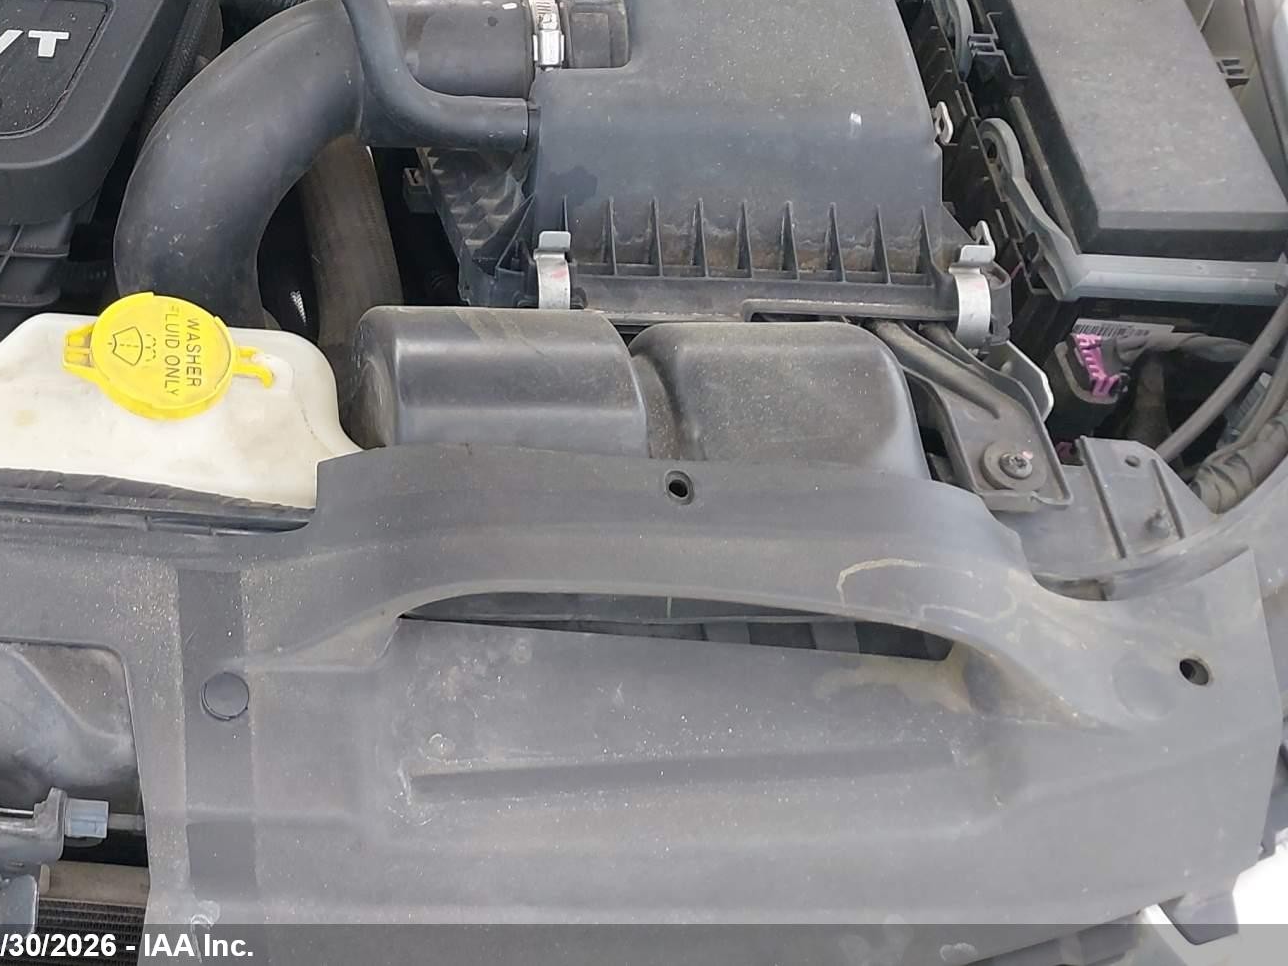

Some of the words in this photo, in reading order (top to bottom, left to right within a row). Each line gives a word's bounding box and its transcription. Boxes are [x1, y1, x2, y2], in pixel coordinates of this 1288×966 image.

[163, 305, 181, 350] FLUID
[185, 318, 202, 388] WASHER
[163, 355, 181, 397] ONLY
